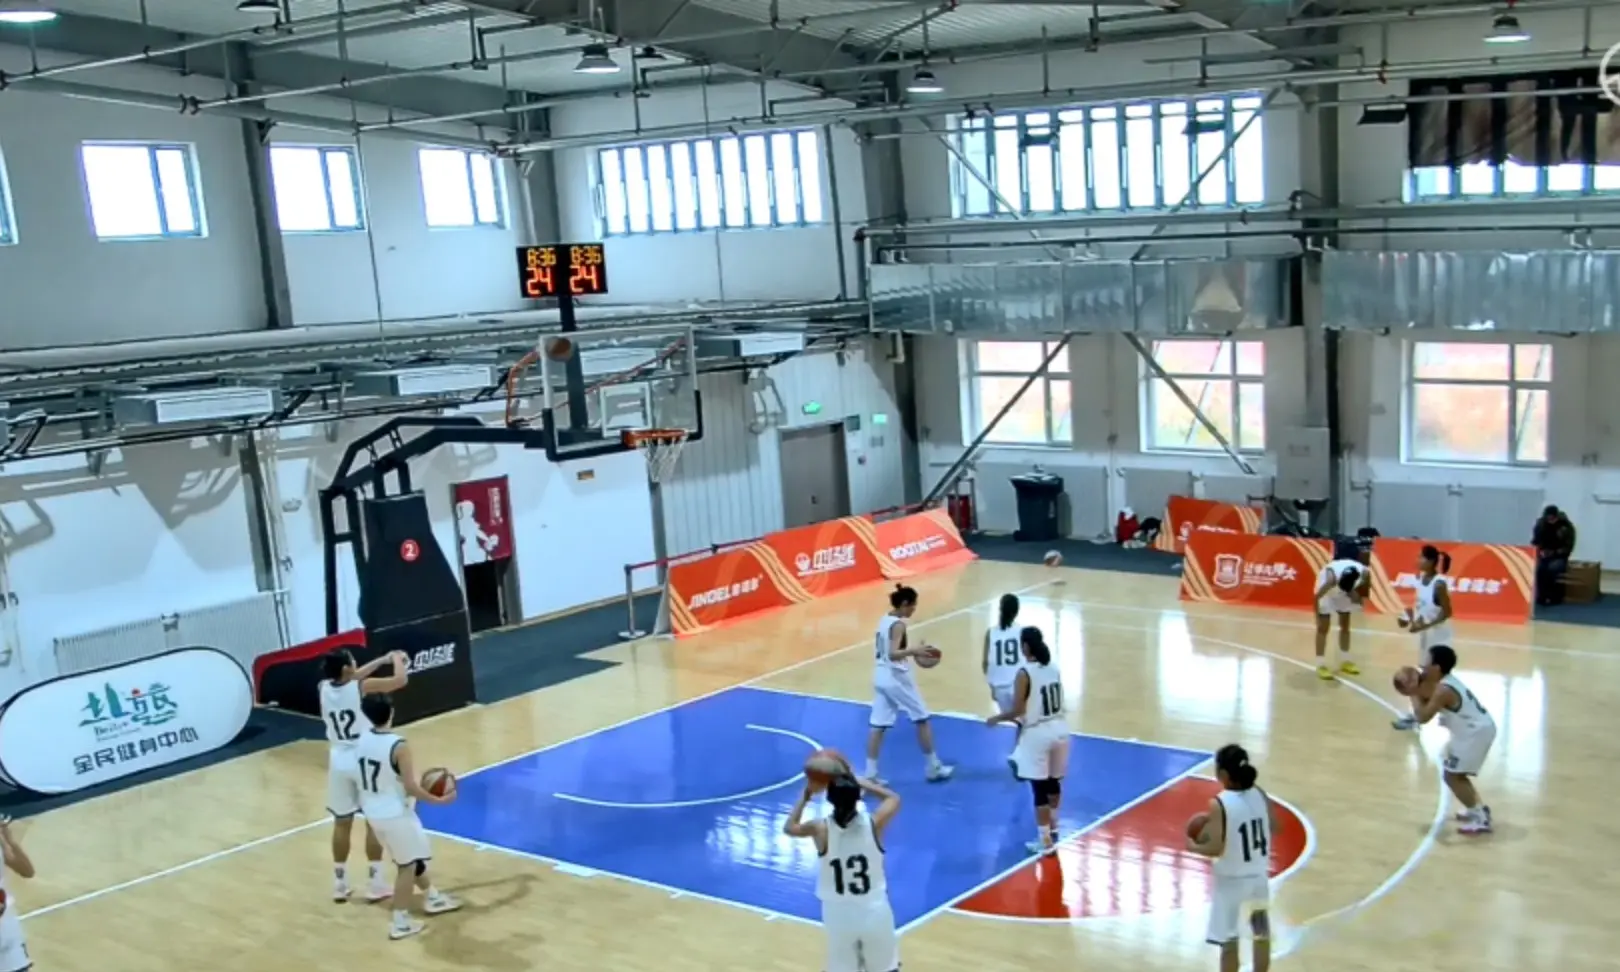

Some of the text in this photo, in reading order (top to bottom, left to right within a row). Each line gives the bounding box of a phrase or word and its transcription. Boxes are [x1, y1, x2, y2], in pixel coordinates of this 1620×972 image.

[526, 267, 553, 295] 24
[569, 265, 598, 293] 24
[995, 638, 1019, 667] 19
[1039, 682, 1062, 717] 10
[329, 709, 360, 740] 12
[358, 756, 382, 792] 17
[1238, 818, 1267, 862] 14
[829, 853, 871, 895] 13
